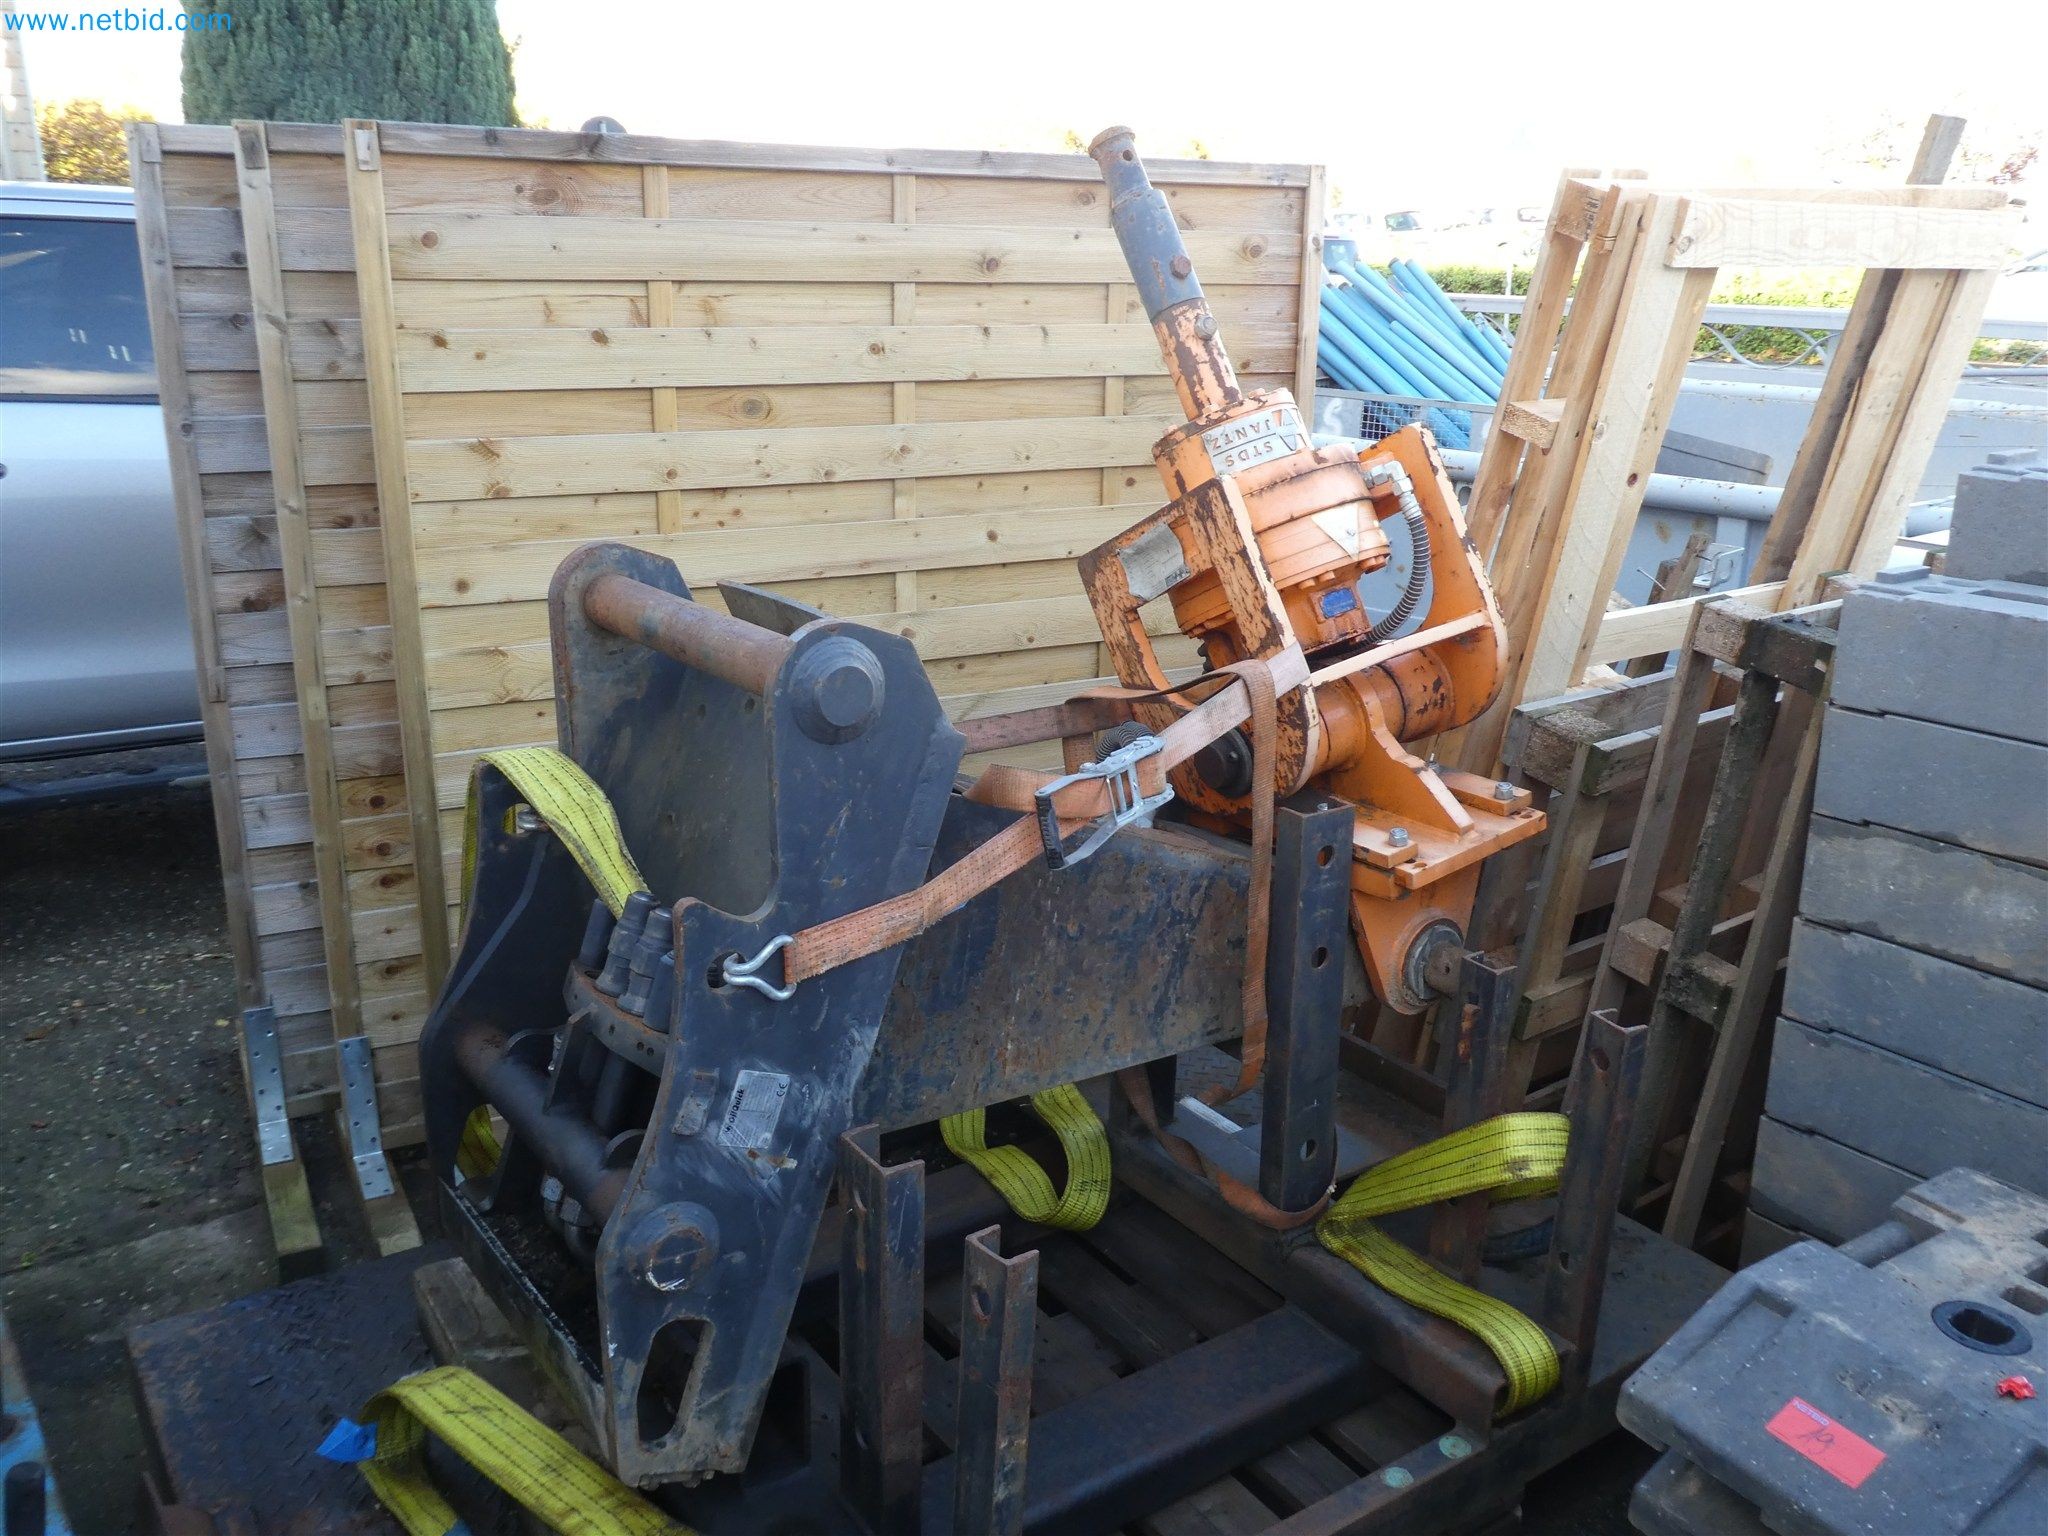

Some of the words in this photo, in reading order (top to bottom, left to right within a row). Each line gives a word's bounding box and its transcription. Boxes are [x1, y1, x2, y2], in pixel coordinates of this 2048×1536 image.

[1211, 419, 1271, 451] JANTZ
[1224, 441, 1273, 467] STDS
[729, 1088, 744, 1124] OilQuick
